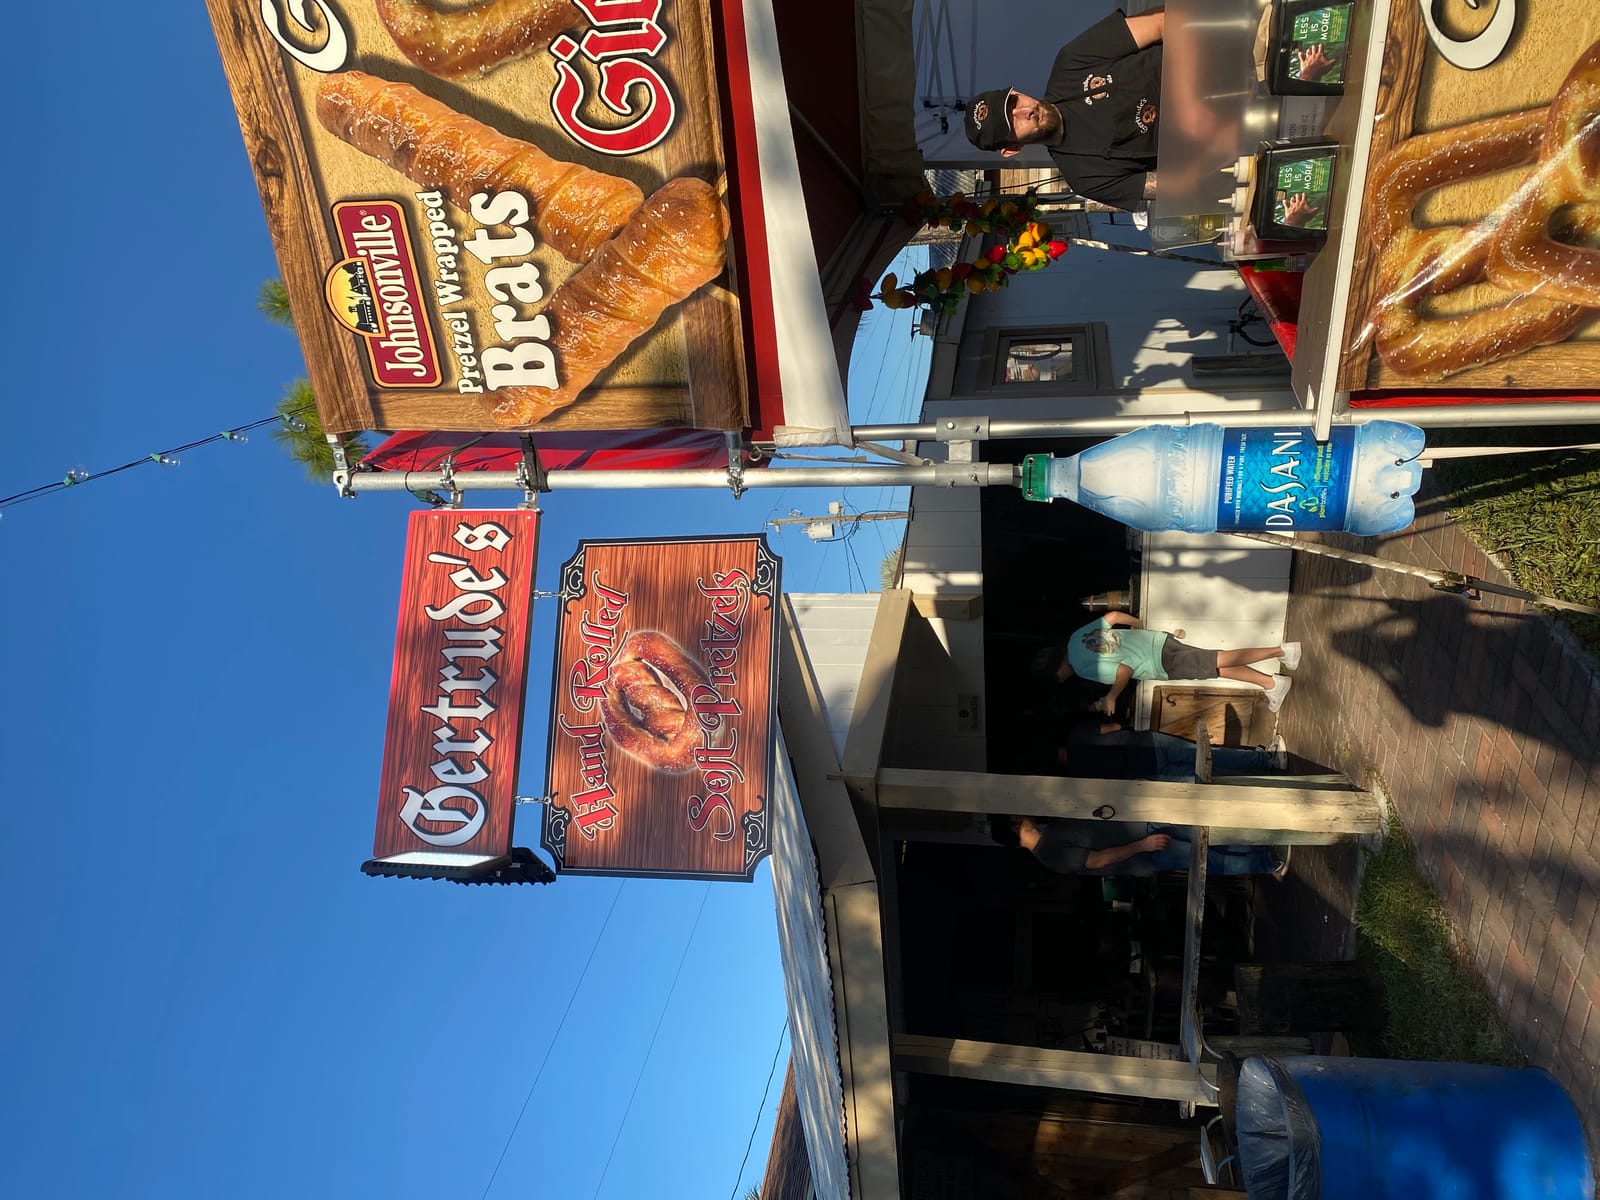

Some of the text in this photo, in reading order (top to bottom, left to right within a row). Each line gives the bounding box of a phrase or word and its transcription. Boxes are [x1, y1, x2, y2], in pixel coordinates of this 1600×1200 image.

[1299, 16, 1309, 39] LESS
[1310, 24, 1319, 32] IS
[1320, 12, 1330, 40] MORE
[1283, 167, 1293, 188] LESS
[1294, 173, 1302, 181] IS
[1304, 162, 1314, 190] MORE
[415, 190, 484, 394] Pretzel Wrapped
[463, 190, 560, 391] Brats
[1224, 455, 1236, 504] PURIFIED WATER
[1260, 431, 1305, 526] DASANI
[398, 521, 512, 846] Gertrude's
[559, 570, 628, 840] Hand Rolled
[687, 568, 749, 841] Soft Pretzels
